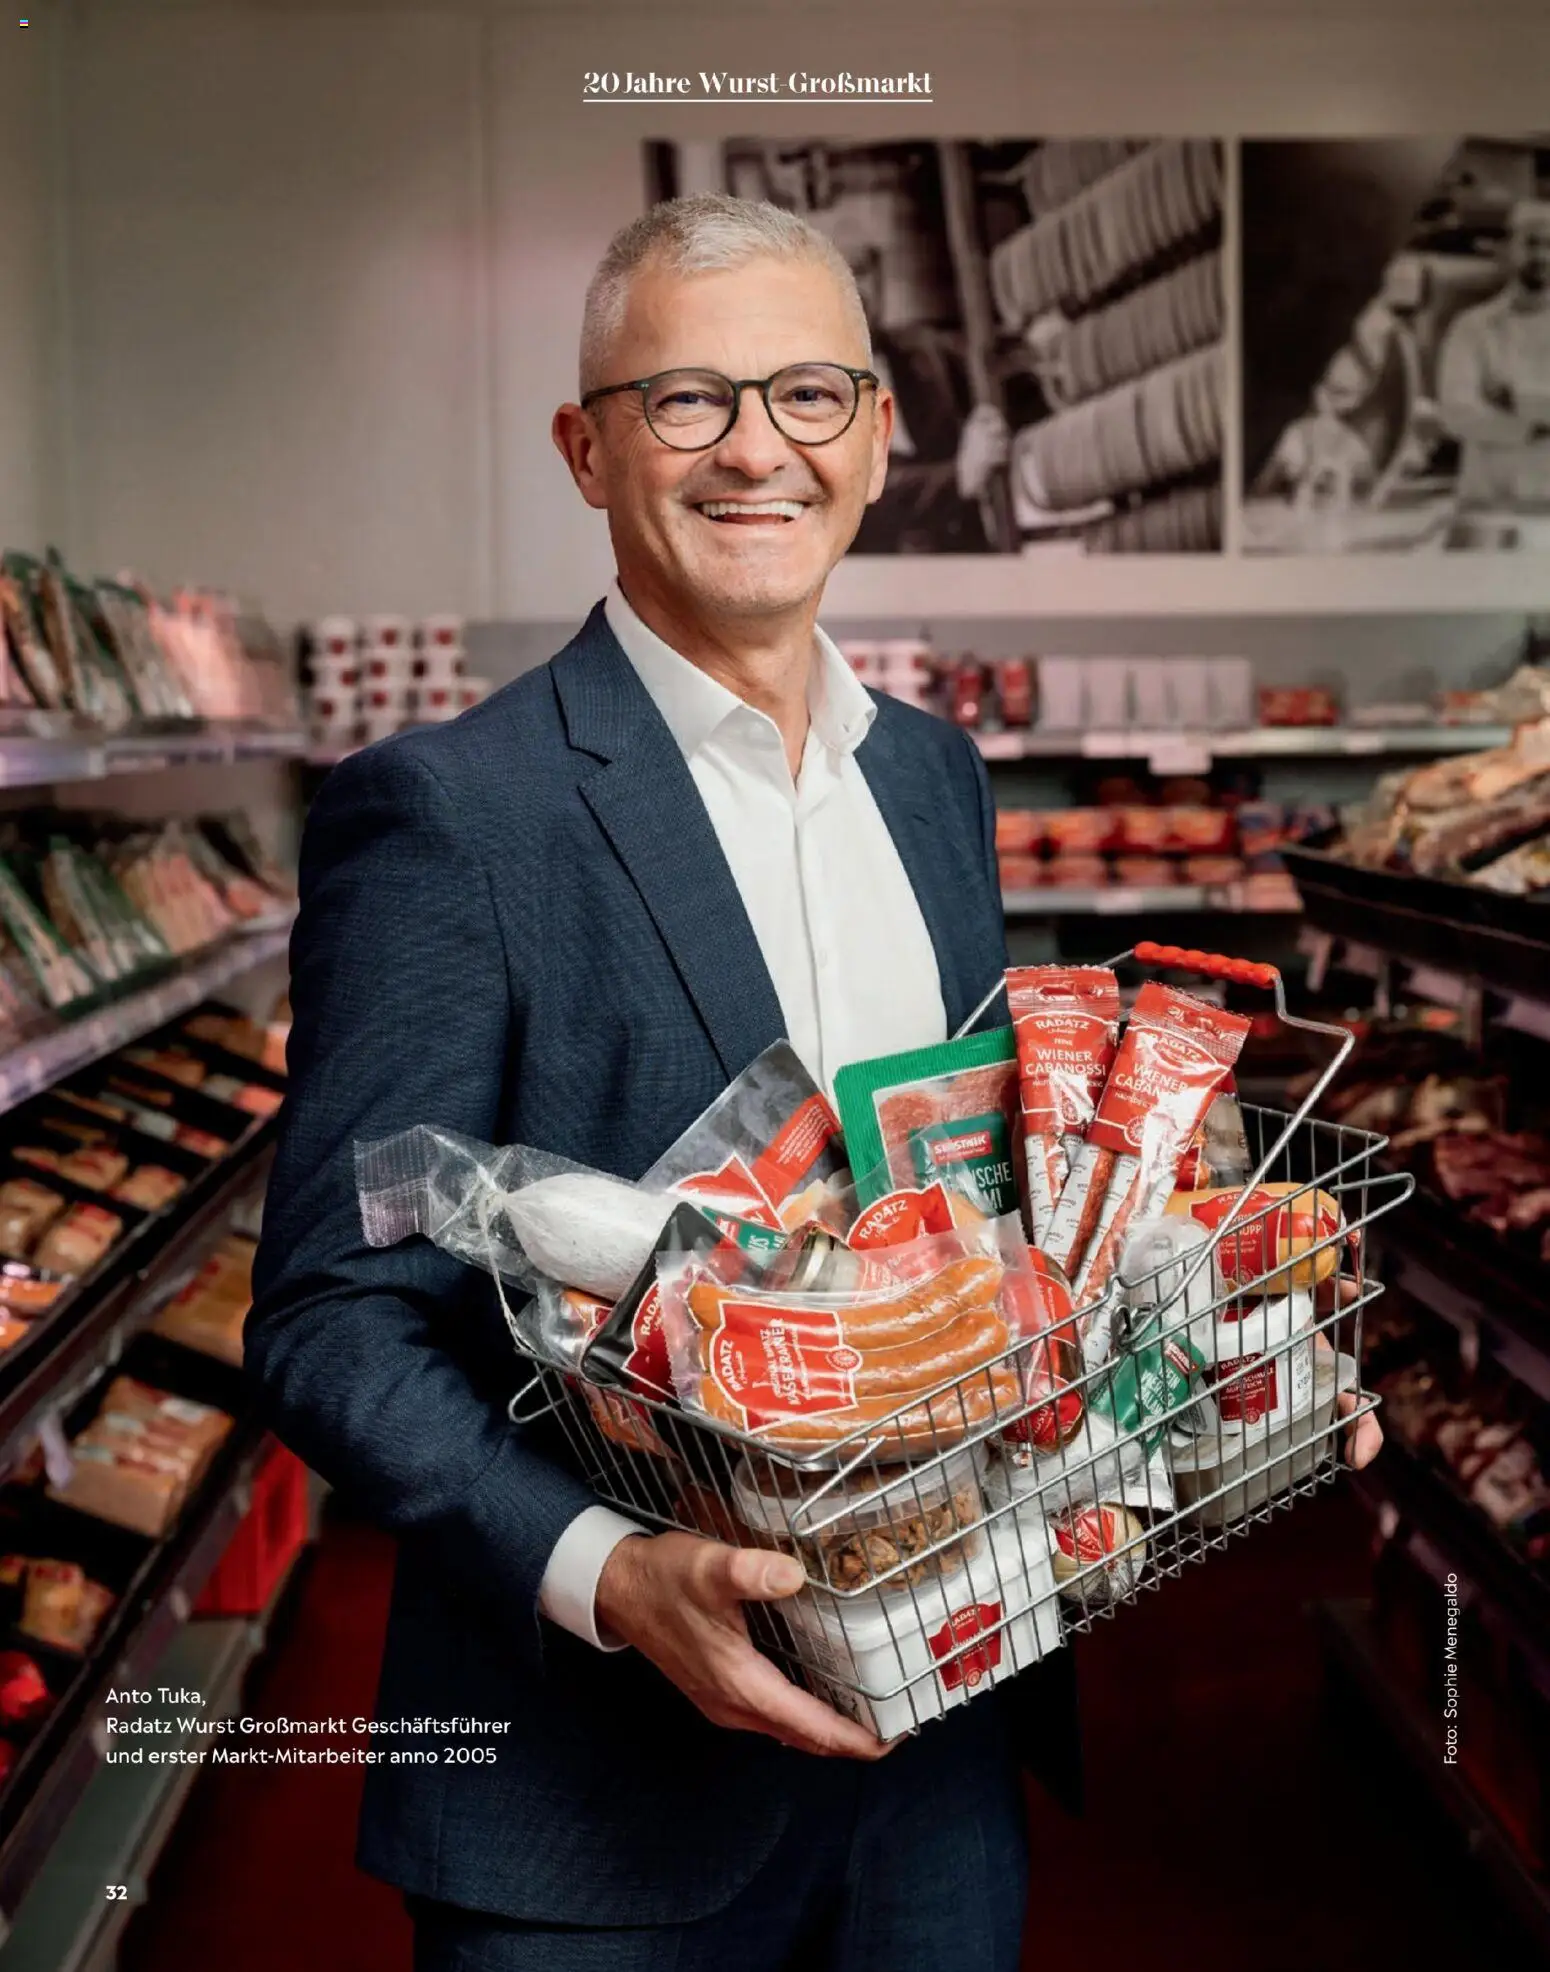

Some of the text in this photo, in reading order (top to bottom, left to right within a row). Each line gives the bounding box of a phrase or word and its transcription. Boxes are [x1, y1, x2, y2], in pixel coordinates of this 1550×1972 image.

[1035, 1018, 1090, 1030] RADATZ
[1036, 1048, 1093, 1062] WIENER
[1025, 1062, 1106, 1077] CABANOSSI
[934, 1134, 987, 1155] SSTNIK
[858, 1199, 909, 1240] RADATZ
[720, 1338, 745, 1392] RADATZ
[1221, 1355, 1256, 1371] RADTZ
